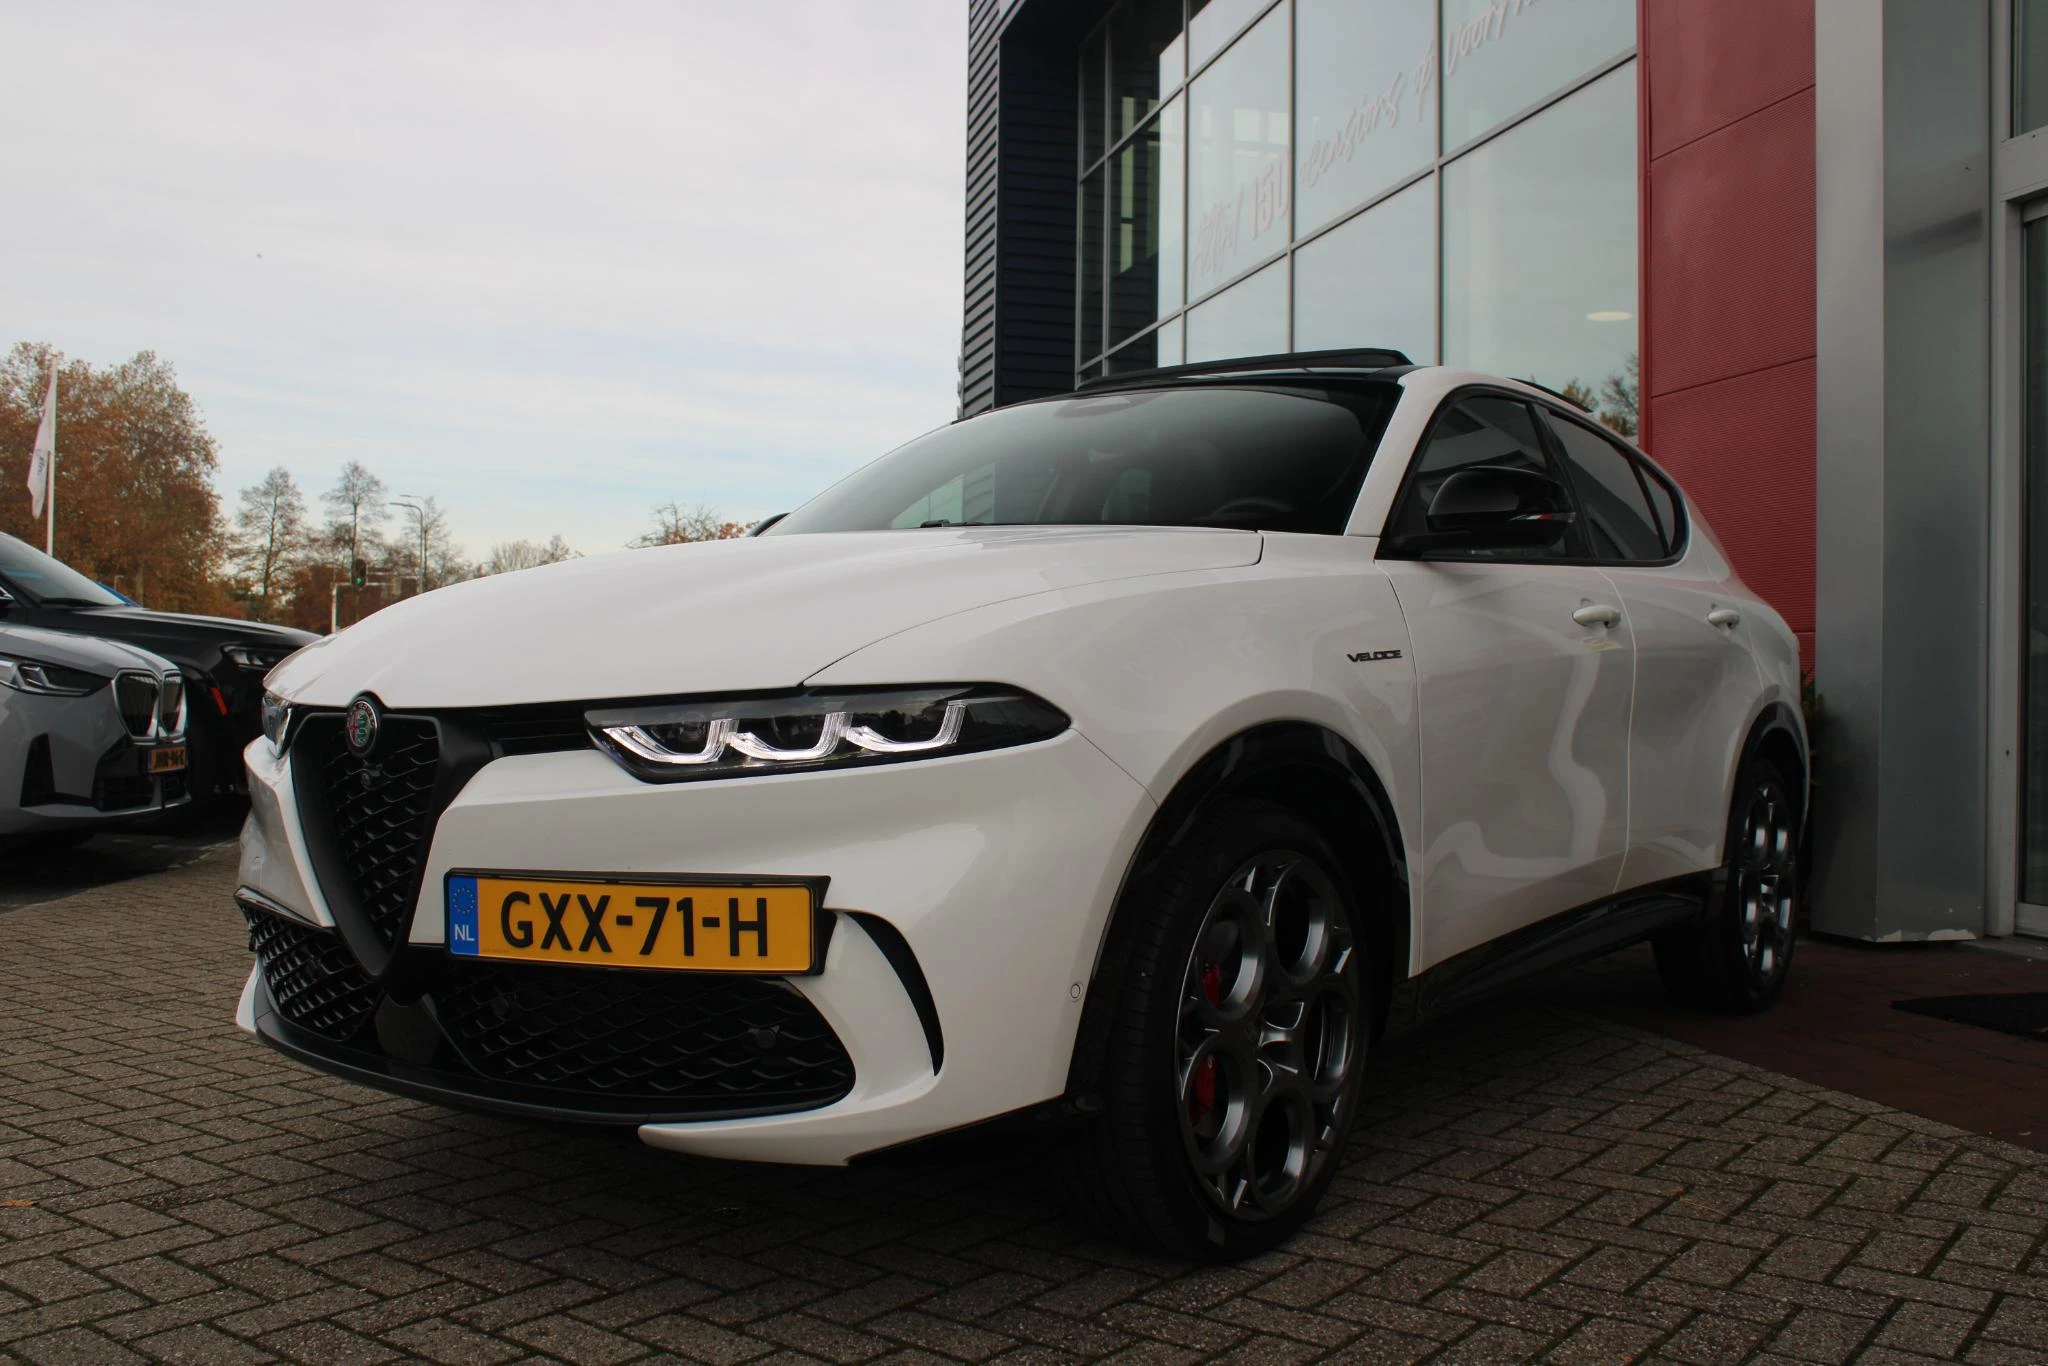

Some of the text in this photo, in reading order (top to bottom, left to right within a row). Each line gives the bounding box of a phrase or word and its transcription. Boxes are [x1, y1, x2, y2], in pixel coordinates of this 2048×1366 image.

[1347, 650, 1403, 662] VELOCE
[454, 923, 475, 942] NL
[501, 891, 768, 957] GXX-71-H
